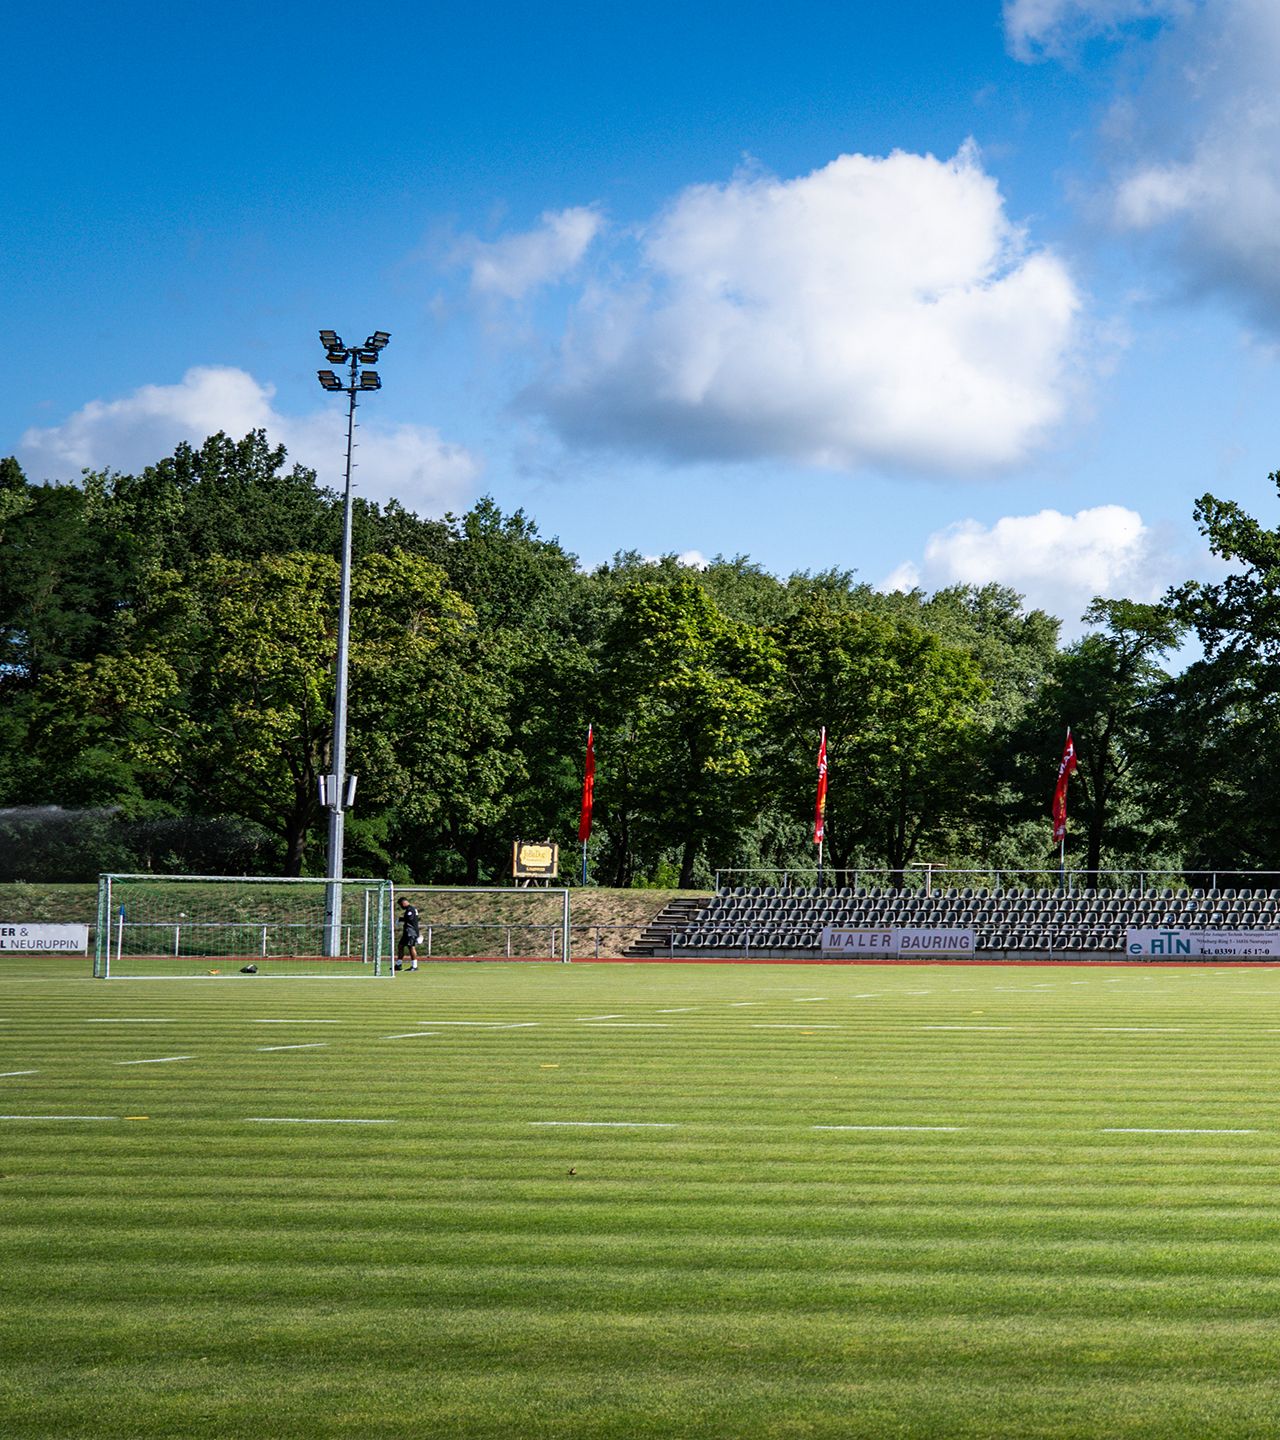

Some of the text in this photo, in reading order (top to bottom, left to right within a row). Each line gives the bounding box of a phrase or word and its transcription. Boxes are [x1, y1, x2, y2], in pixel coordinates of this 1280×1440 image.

[20, 927, 29, 937] &
[11, 939, 79, 949] NEURUPPIN
[829, 934, 970, 949] MALER BAURING
